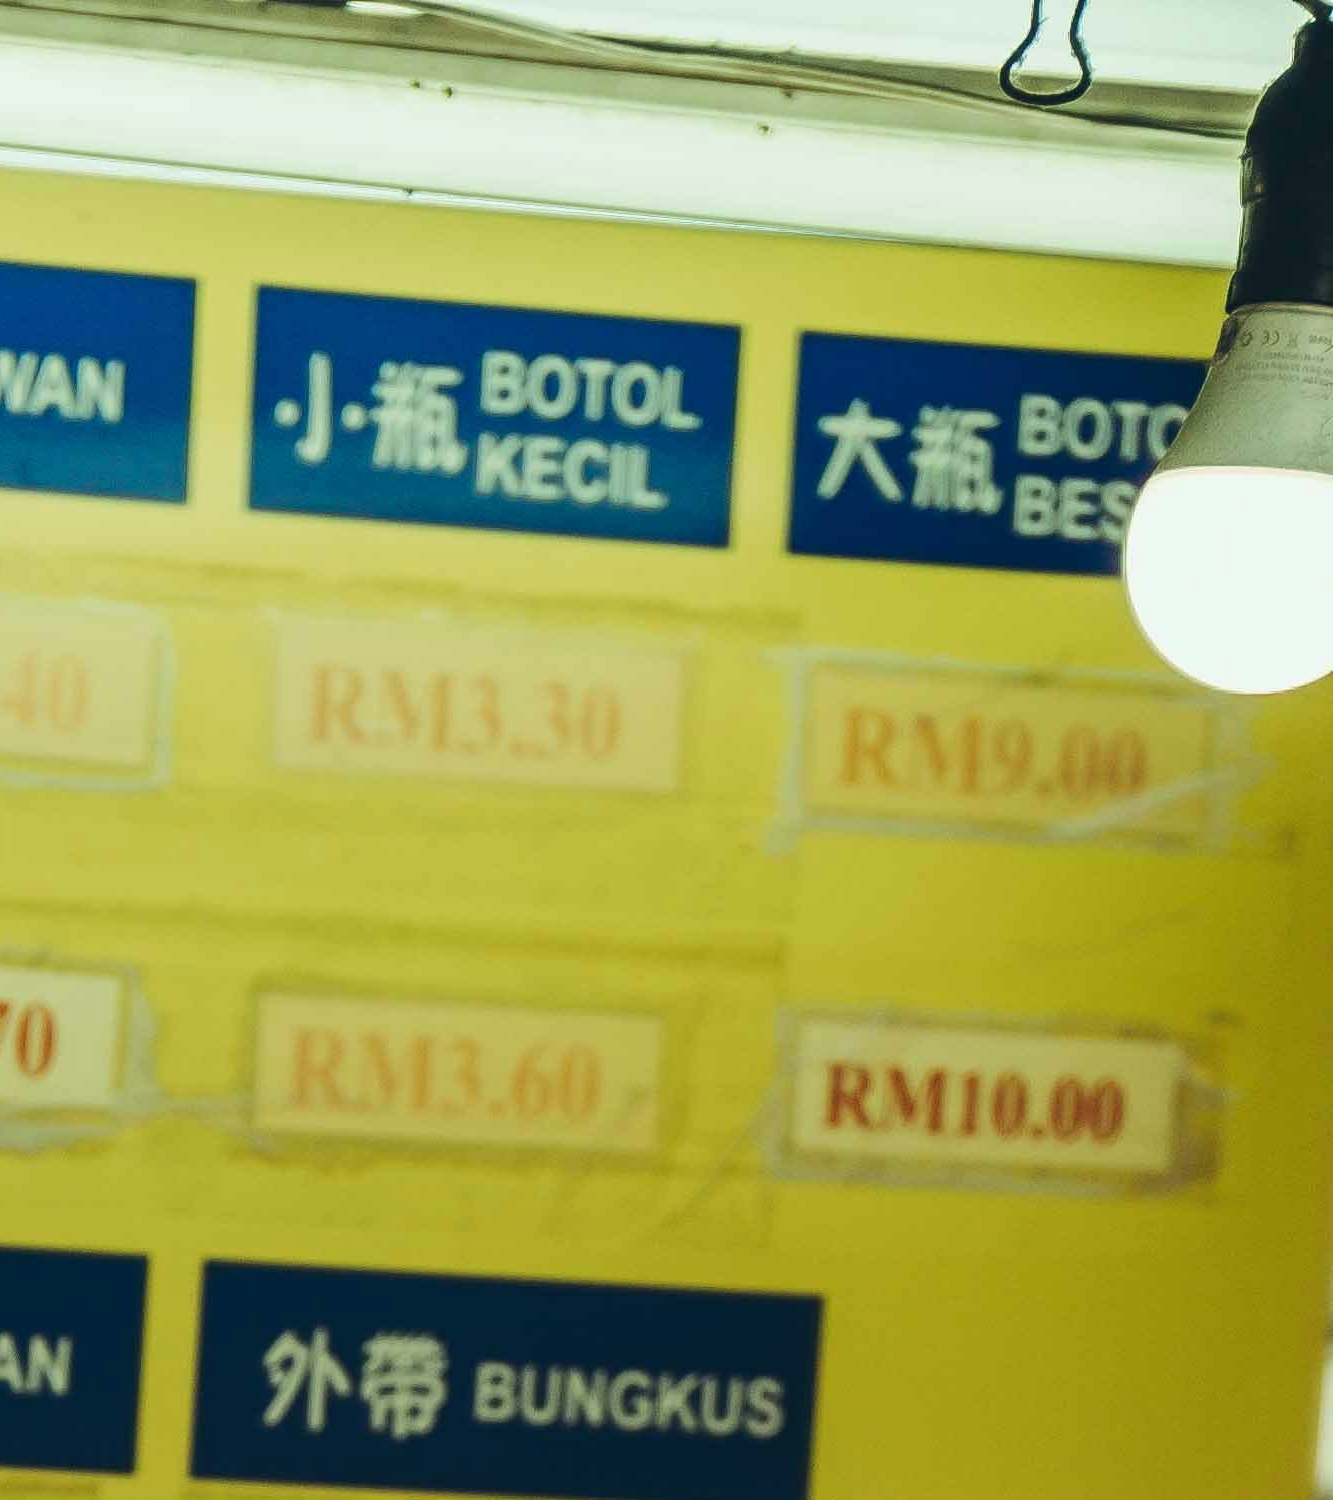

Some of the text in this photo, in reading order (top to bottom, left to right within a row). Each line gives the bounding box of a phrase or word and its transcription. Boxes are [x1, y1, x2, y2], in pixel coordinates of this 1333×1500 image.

[274, 351, 469, 474] 小瓶
[479, 348, 703, 431] BOTOL
[1017, 392, 1189, 464] BOTO
[473, 430, 669, 511] KECIL
[816, 397, 1003, 515] 大瓶
[1011, 473, 1139, 543] BES
[308, 662, 623, 762] RM3.30
[838, 704, 1152, 801] RM9.00
[289, 1024, 602, 1124] RM3.60
[822, 1060, 1126, 1147] RM10.00
[261, 1326, 787, 1440] 外帶 BUNGKUS
